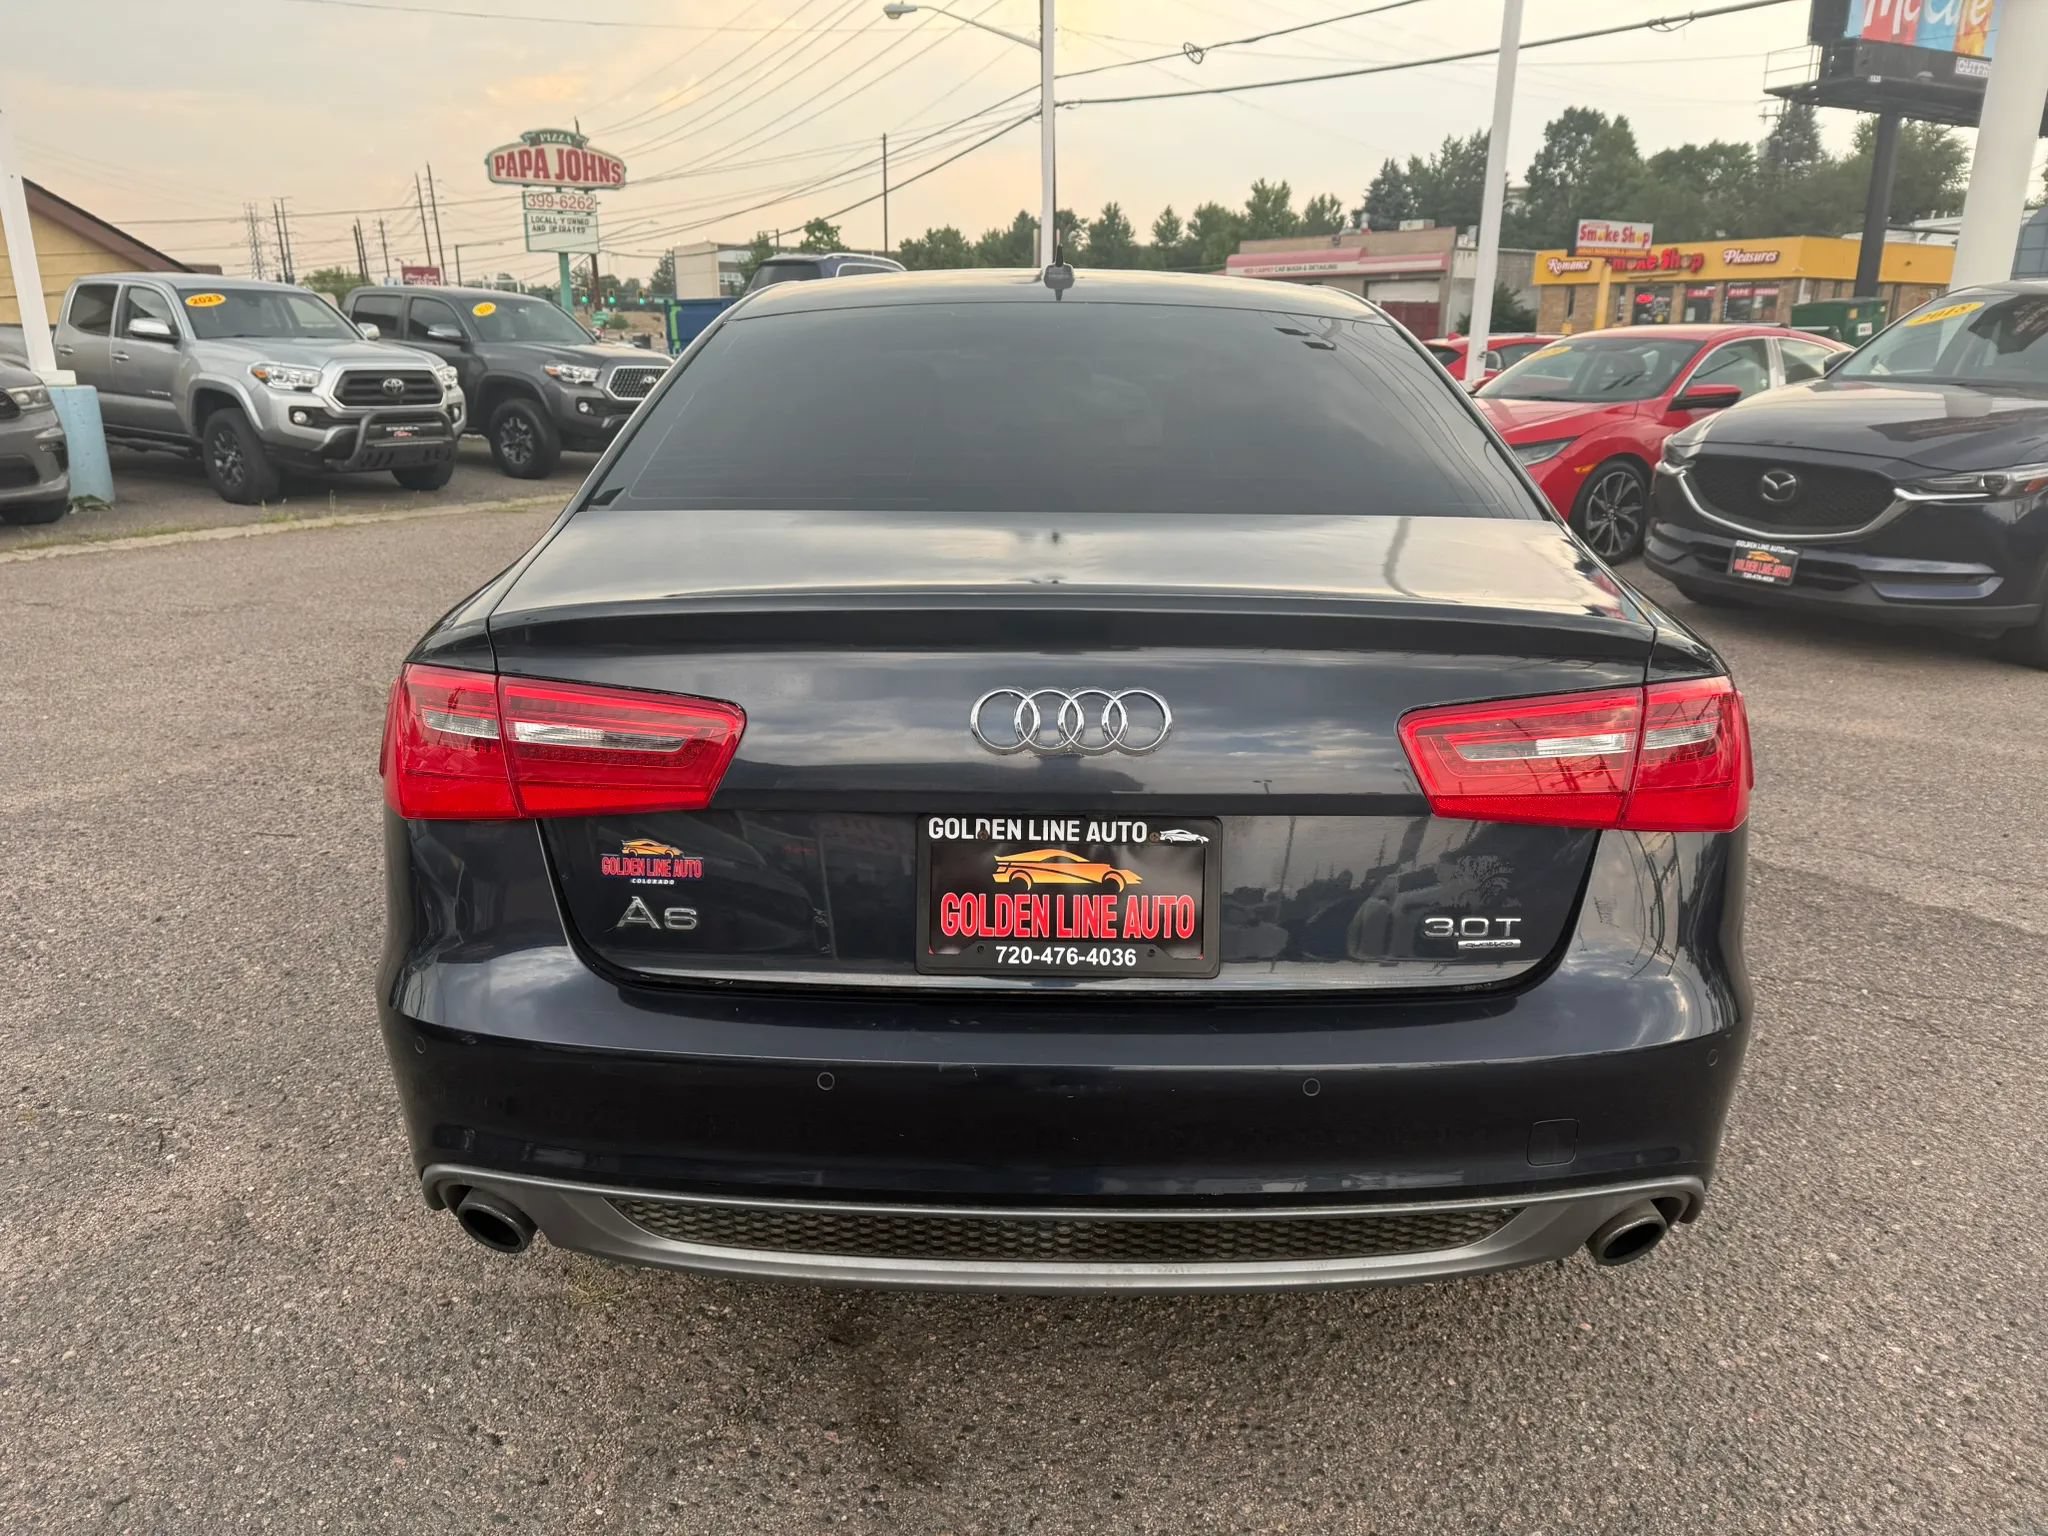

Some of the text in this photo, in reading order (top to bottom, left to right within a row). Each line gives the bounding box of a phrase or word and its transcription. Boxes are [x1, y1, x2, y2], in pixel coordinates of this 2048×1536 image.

[540, 134, 571, 144] PIZZA
[494, 147, 550, 179] PAPA
[527, 193, 595, 210] 399-6262
[1580, 224, 1650, 248] Smoke Shop
[1548, 258, 1591, 275] Romance
[1660, 247, 1705, 273] Shop
[1724, 249, 1779, 265] Pleasures
[928, 816, 1148, 843] GOLDEN LINE AUTO
[601, 856, 702, 878] GOLDEN LINE AUTO
[616, 896, 697, 930] A6
[940, 892, 1195, 940] GOLDEN LINE AUTO
[1424, 917, 1521, 937] 3.0T
[995, 945, 1137, 967] 720-476-4036
